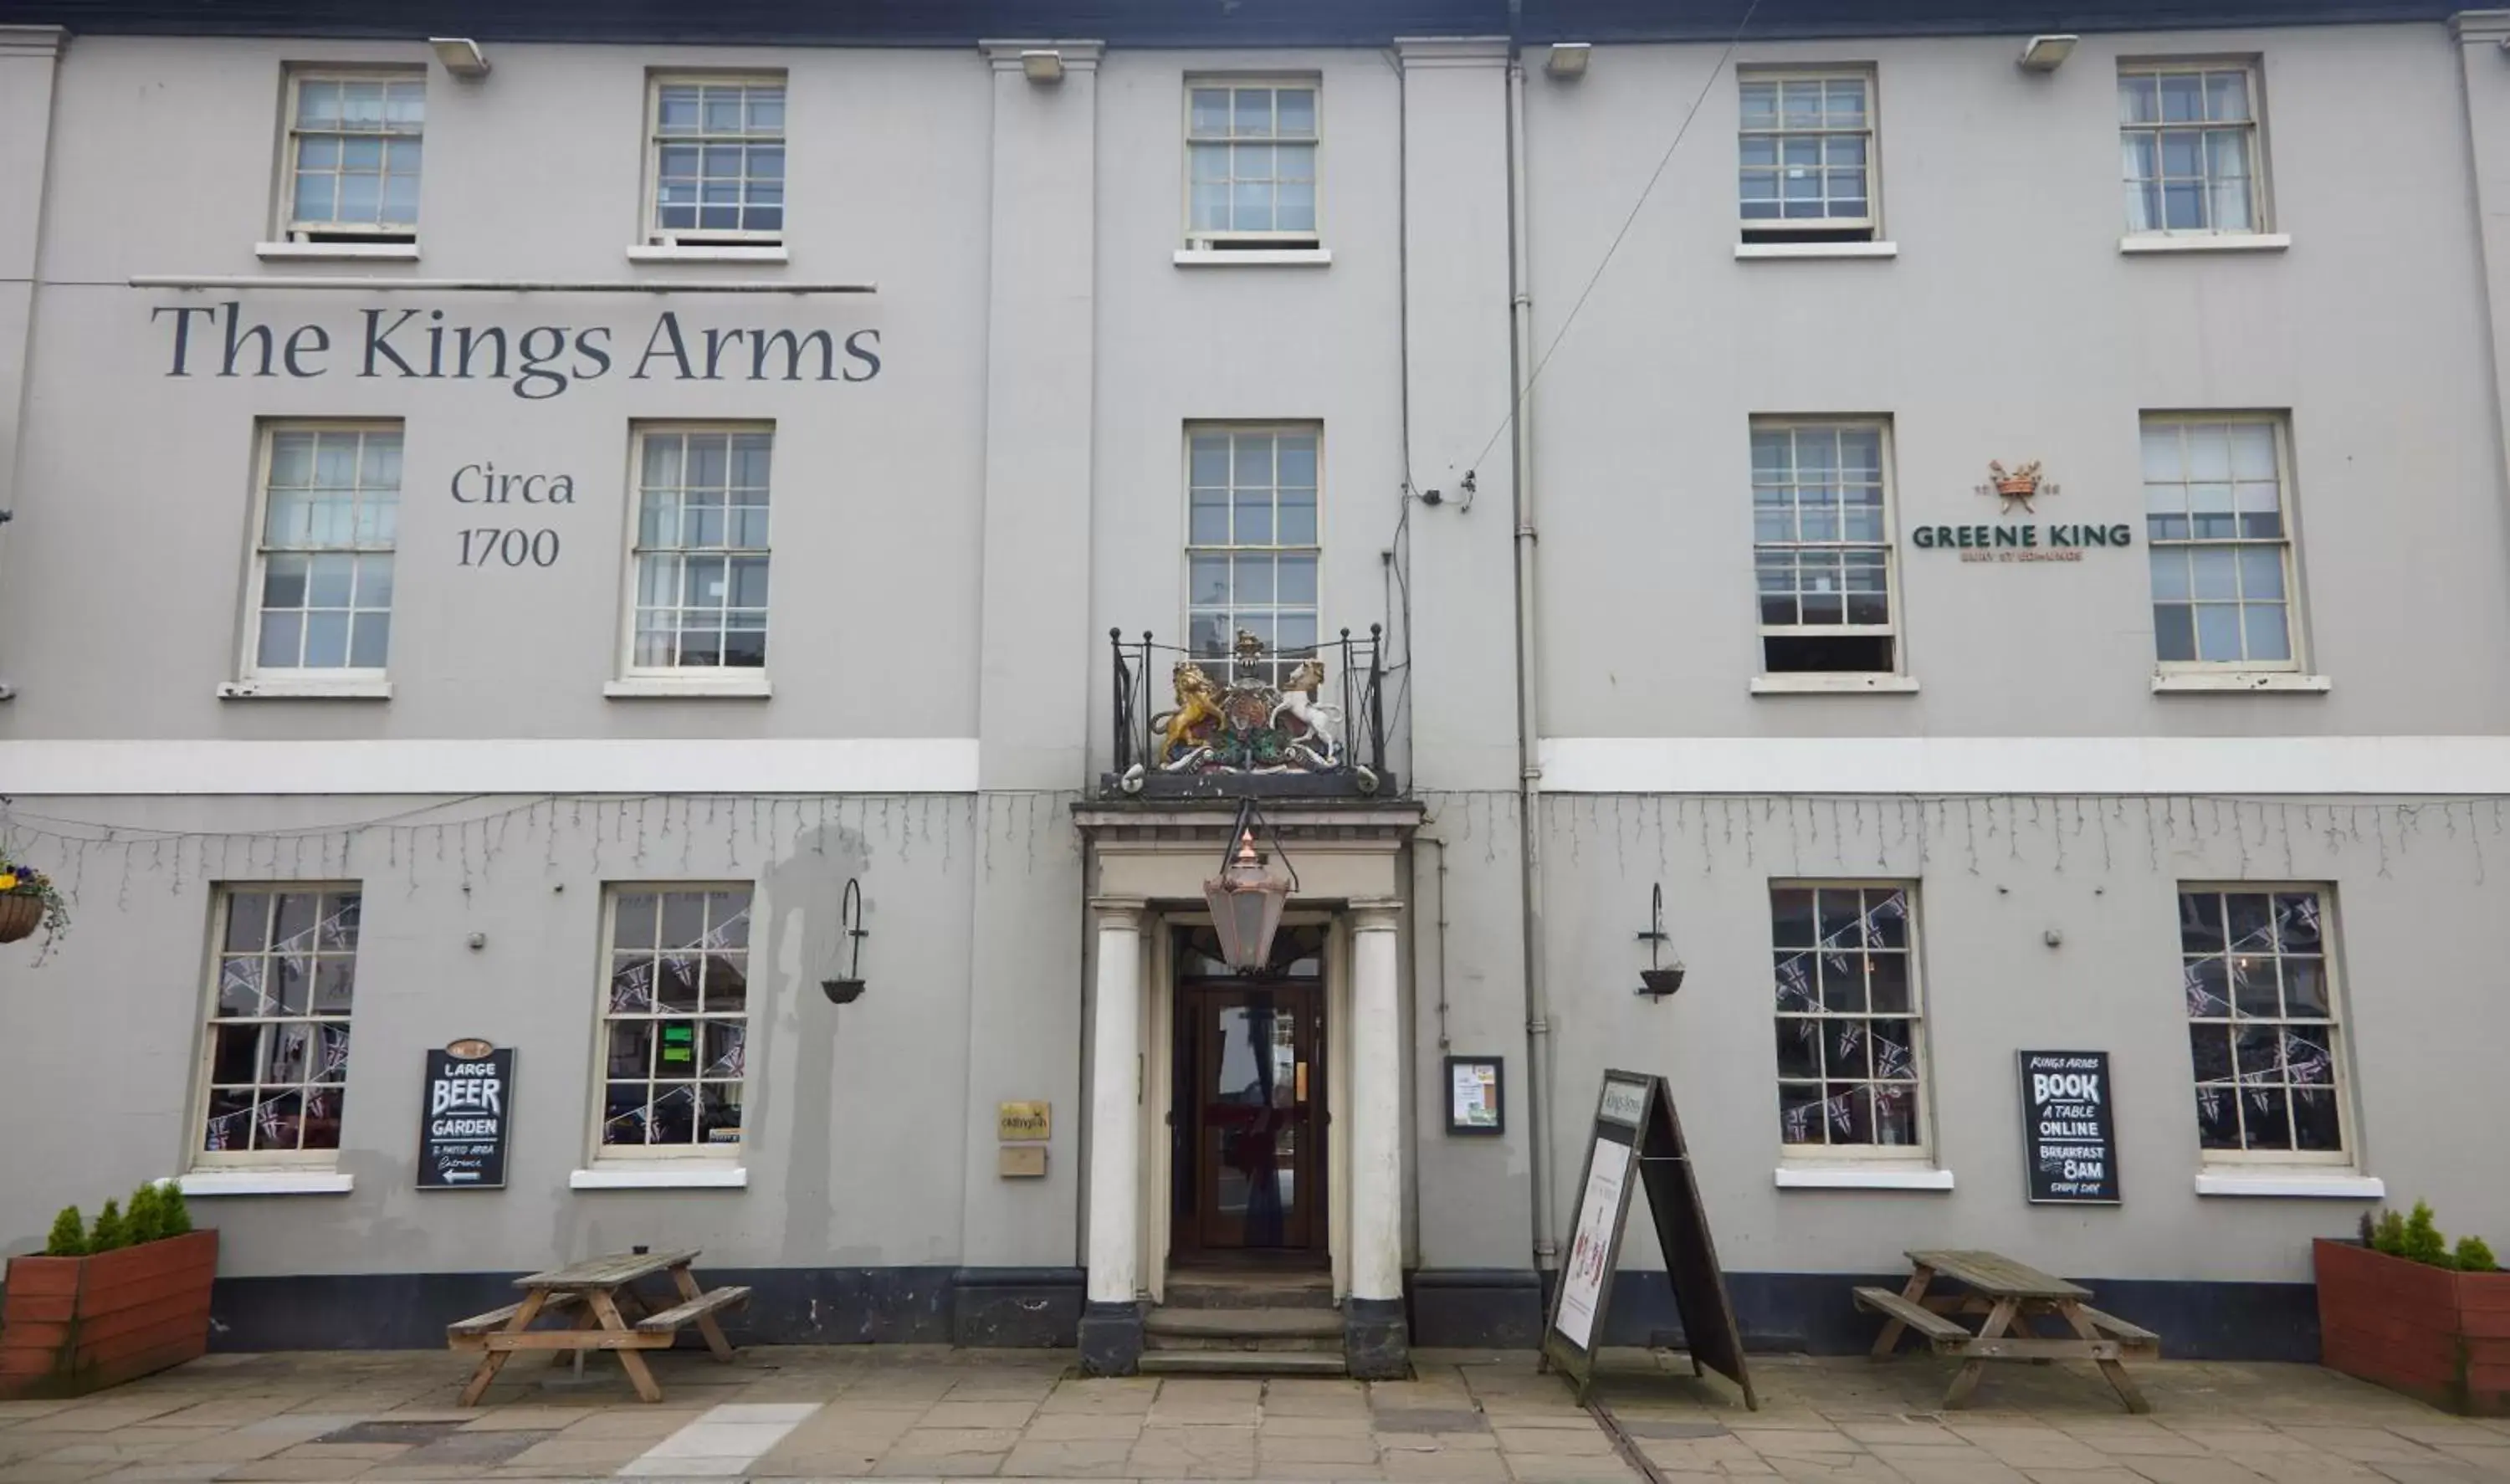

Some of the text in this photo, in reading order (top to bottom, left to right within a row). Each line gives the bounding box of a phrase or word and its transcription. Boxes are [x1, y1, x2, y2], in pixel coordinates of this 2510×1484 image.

[151, 301, 881, 400] The Kings Arms
[451, 464, 574, 504] Circa
[1913, 524, 2131, 550] GREENE KING
[459, 529, 560, 567] 1700
[444, 1063, 496, 1077] LARGE
[2030, 1057, 2098, 1069] KINGS ARMS
[432, 1079, 500, 1117] BEER
[2034, 1074, 2100, 1105] BOOK
[2042, 1106, 2095, 1118] A TABLE
[432, 1119, 498, 1136] GARDEN
[2040, 1122, 2098, 1135] ONLINE
[2040, 1145, 2104, 1159] BREAKFAST
[2064, 1159, 2103, 1180] 8AM
